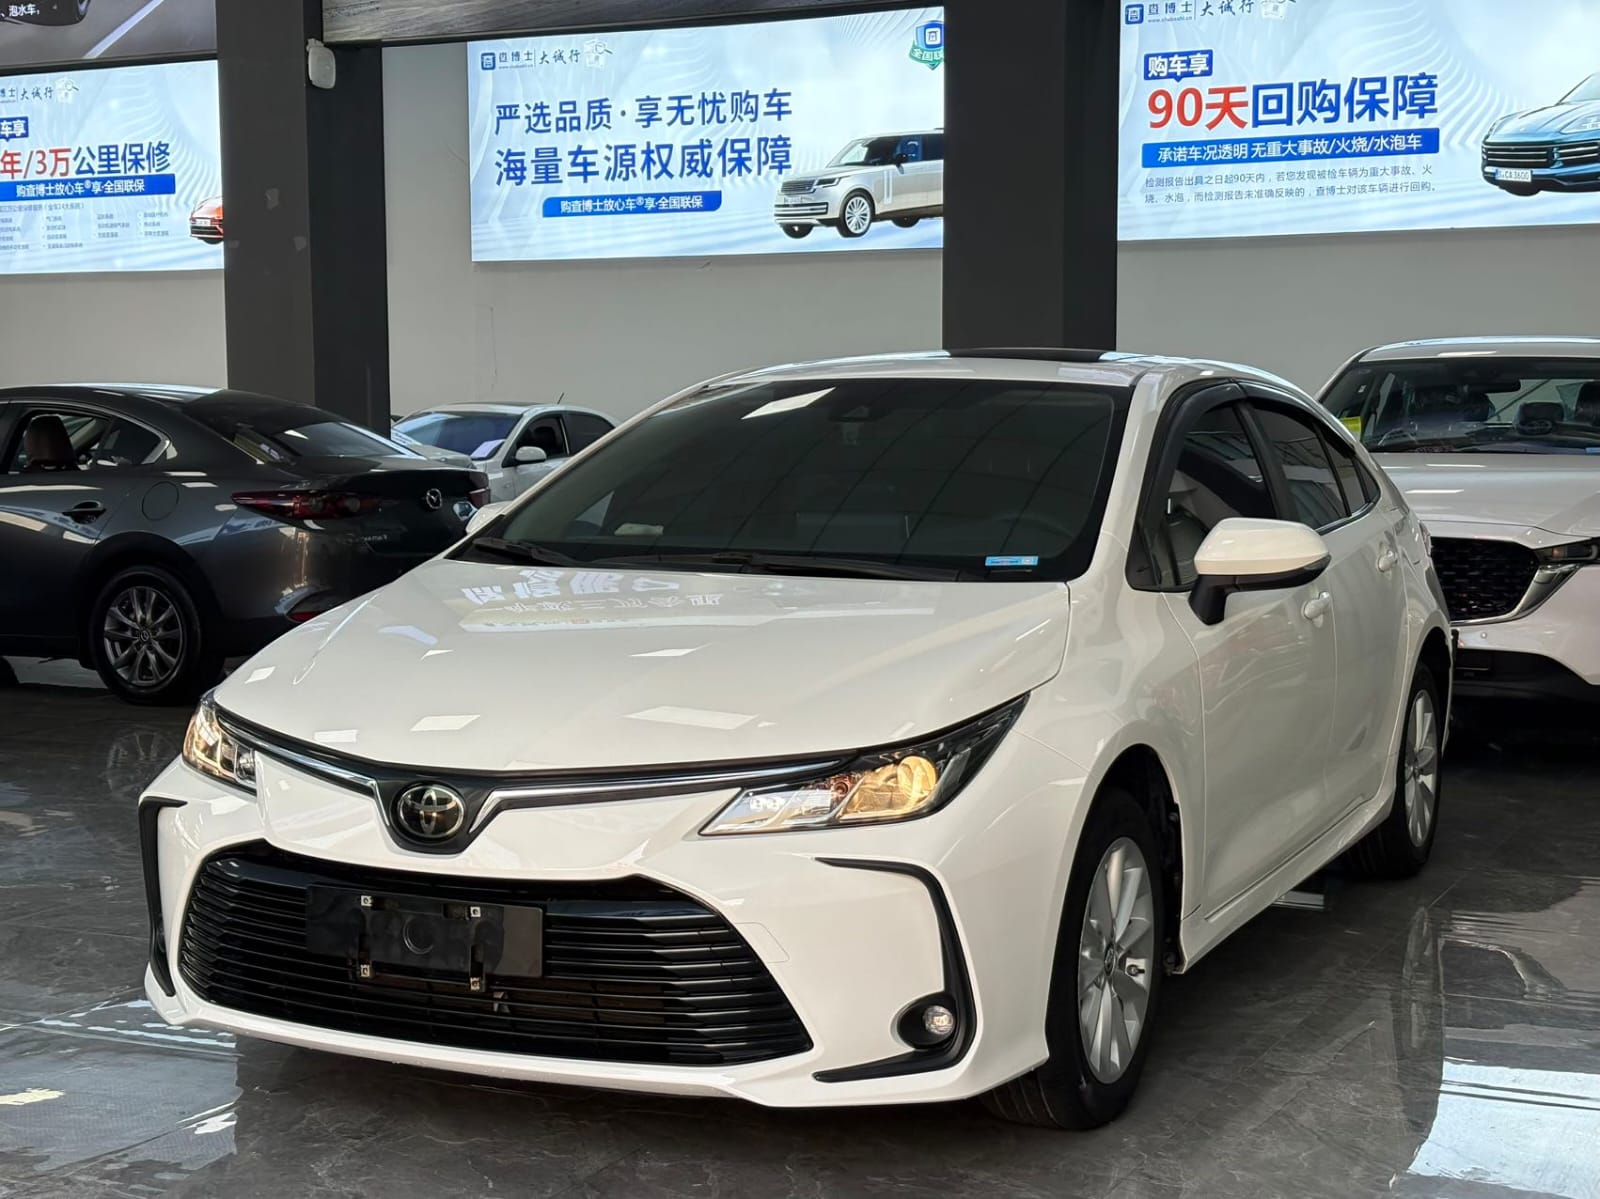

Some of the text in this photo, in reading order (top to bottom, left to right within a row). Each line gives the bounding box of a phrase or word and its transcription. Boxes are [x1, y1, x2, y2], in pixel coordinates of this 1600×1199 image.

[1148, 53, 1209, 77] 购车享
[495, 88, 792, 135] 严选品质·享无忧购车
[1148, 72, 1438, 131] 90天回购保障
[0, 119, 26, 138] 车享
[1158, 133, 1422, 163] 承诺车况透明 无重大事故/火烧/水泡车
[0, 141, 170, 180] 年/3万公里保修
[495, 134, 792, 186] 海量车源权威保障
